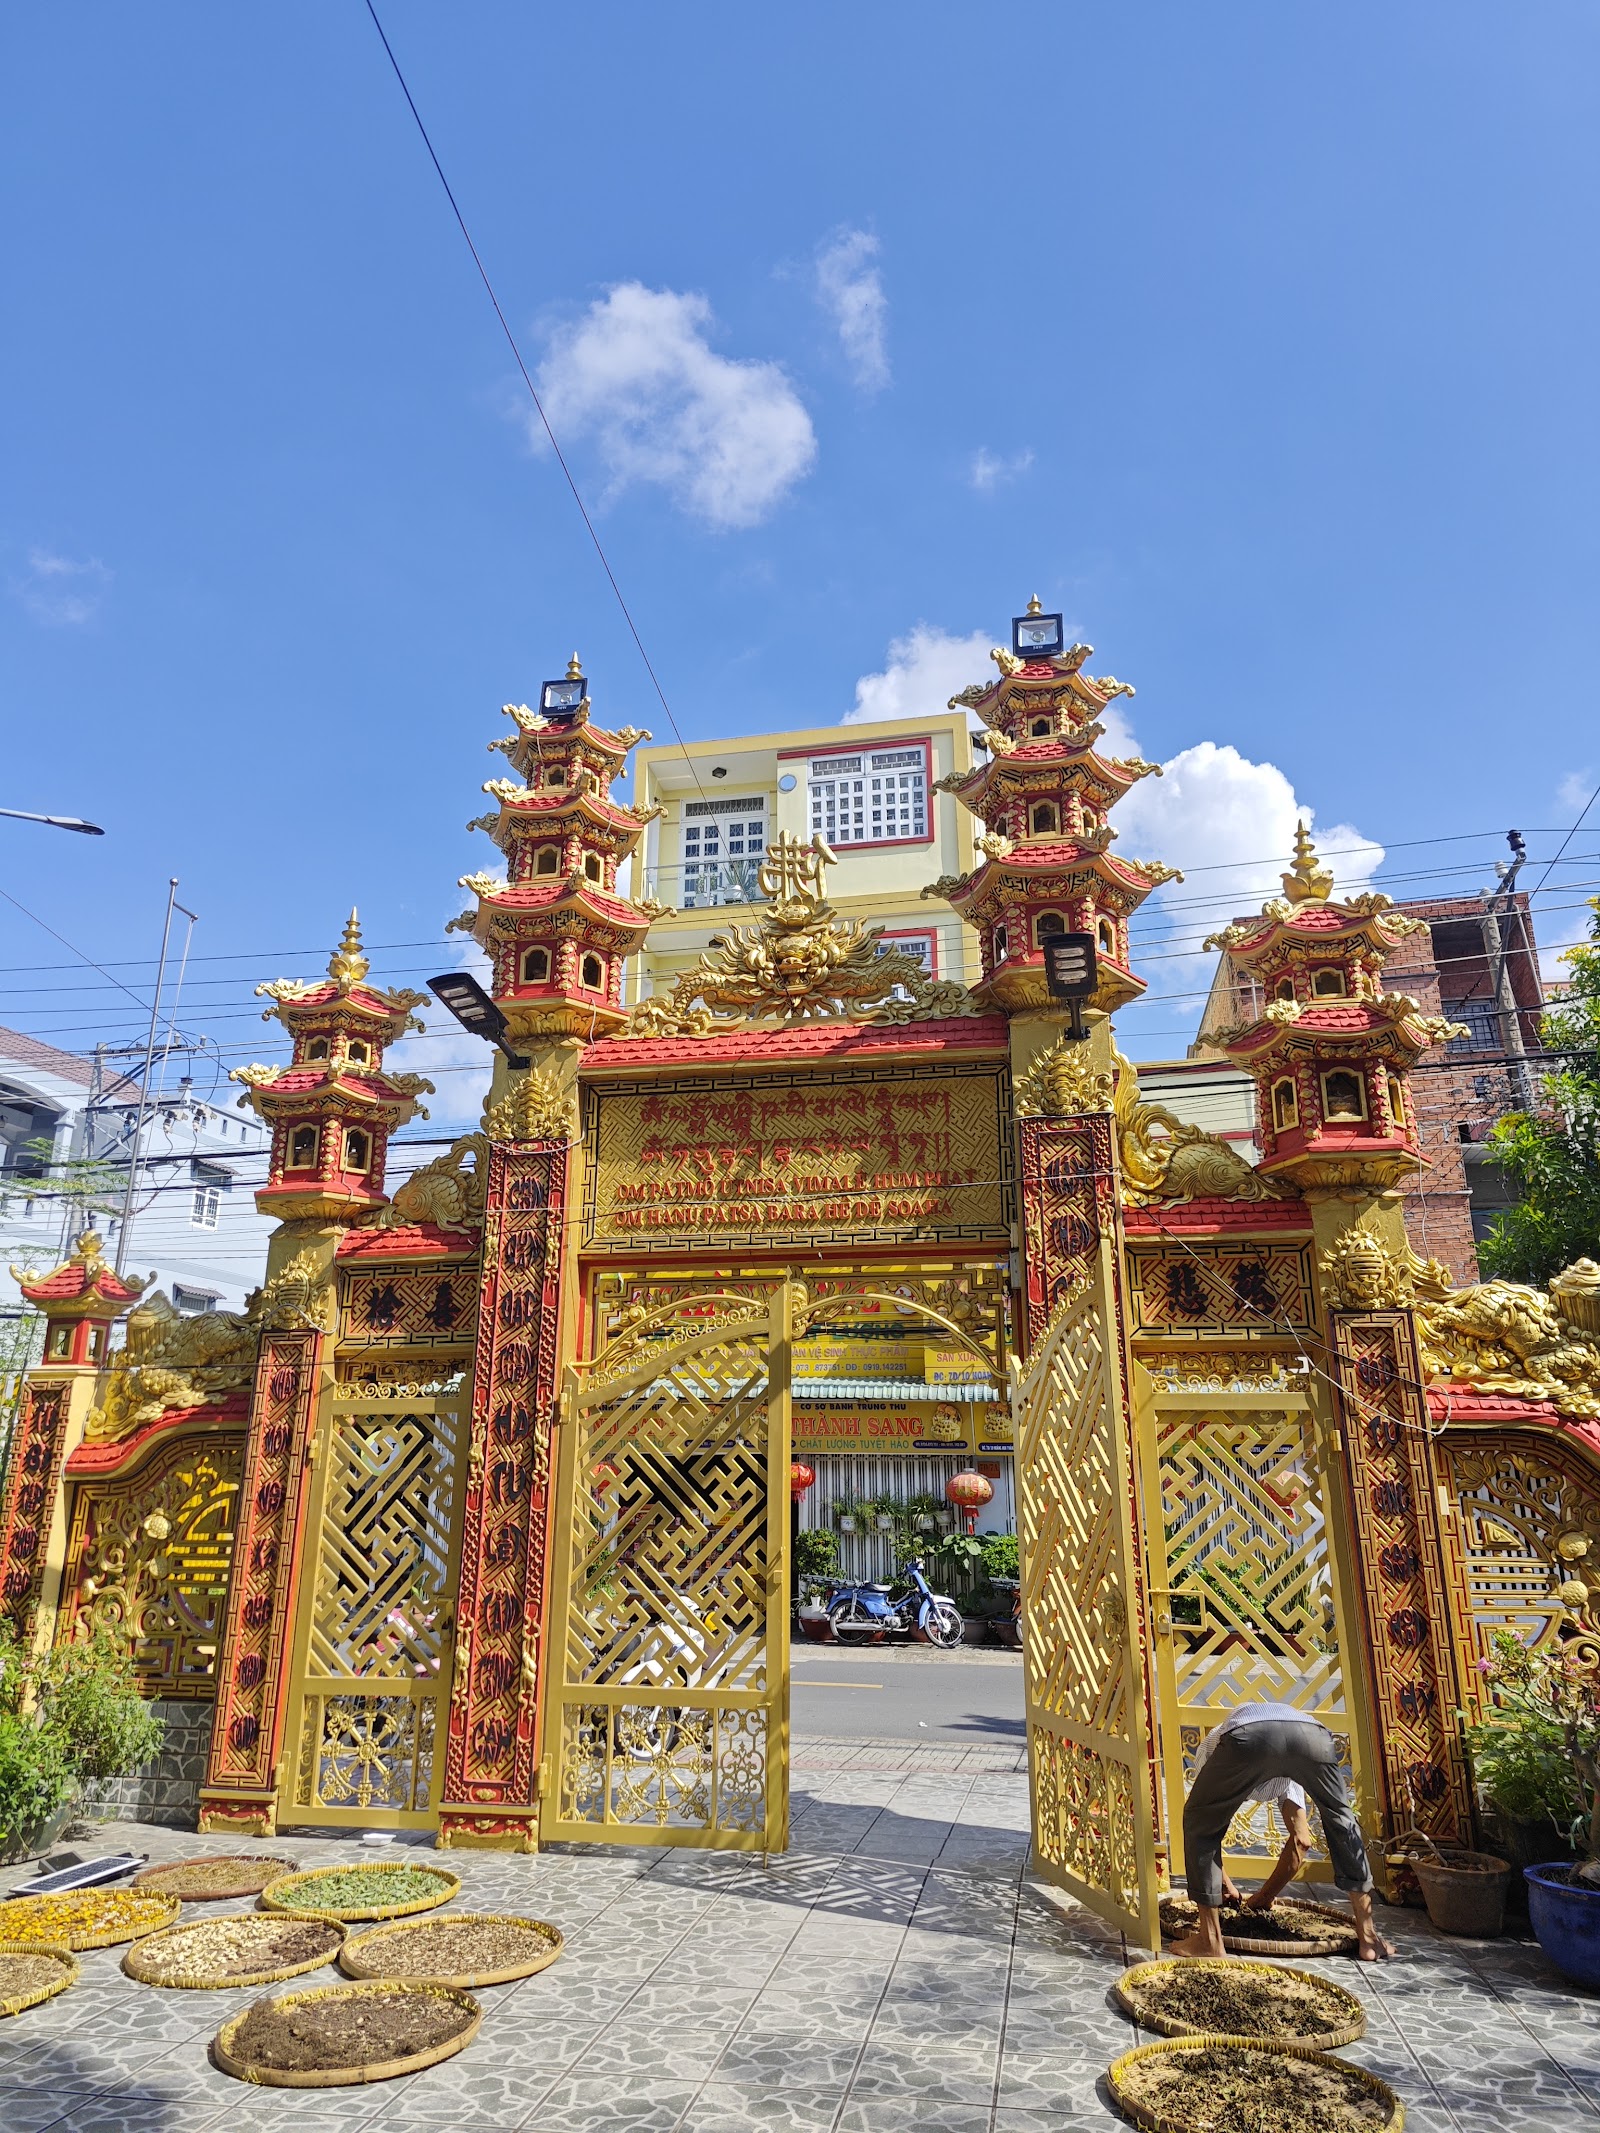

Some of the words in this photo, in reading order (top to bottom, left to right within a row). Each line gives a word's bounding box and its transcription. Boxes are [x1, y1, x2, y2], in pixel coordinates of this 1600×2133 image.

[617, 1184, 645, 1199] OM
[793, 1169, 867, 1192] VIMALÊ
[874, 1171, 919, 1189] HUM
[615, 1211, 643, 1226] OM
[647, 1207, 699, 1225] HANU
[767, 1204, 818, 1222] BARA
[825, 1195, 851, 1219] HÊ
[856, 1194, 881, 1218] DÊ
[888, 1198, 953, 1217] SOAHA
[809, 1344, 822, 1359] VỆ
[824, 1346, 847, 1358] SINH
[849, 1346, 877, 1359] THỰC
[879, 1344, 909, 1358] PHẨM
[936, 1349, 955, 1363] SẢN
[796, 1364, 809, 1372] 073
[863, 1363, 907, 1371] 0919.142251
[856, 1403, 887, 1411] TRUNG
[889, 1403, 906, 1411] THU
[791, 1411, 862, 1437] THÀNH
[867, 1416, 925, 1437] SANG
[799, 1436, 824, 1449] CHẤT
[826, 1437, 856, 1451] LƯỢNG
[859, 1437, 886, 1450] TUYỆT
[890, 1436, 909, 1450] HẢO
[1381, 1543, 1420, 1583] SANH
